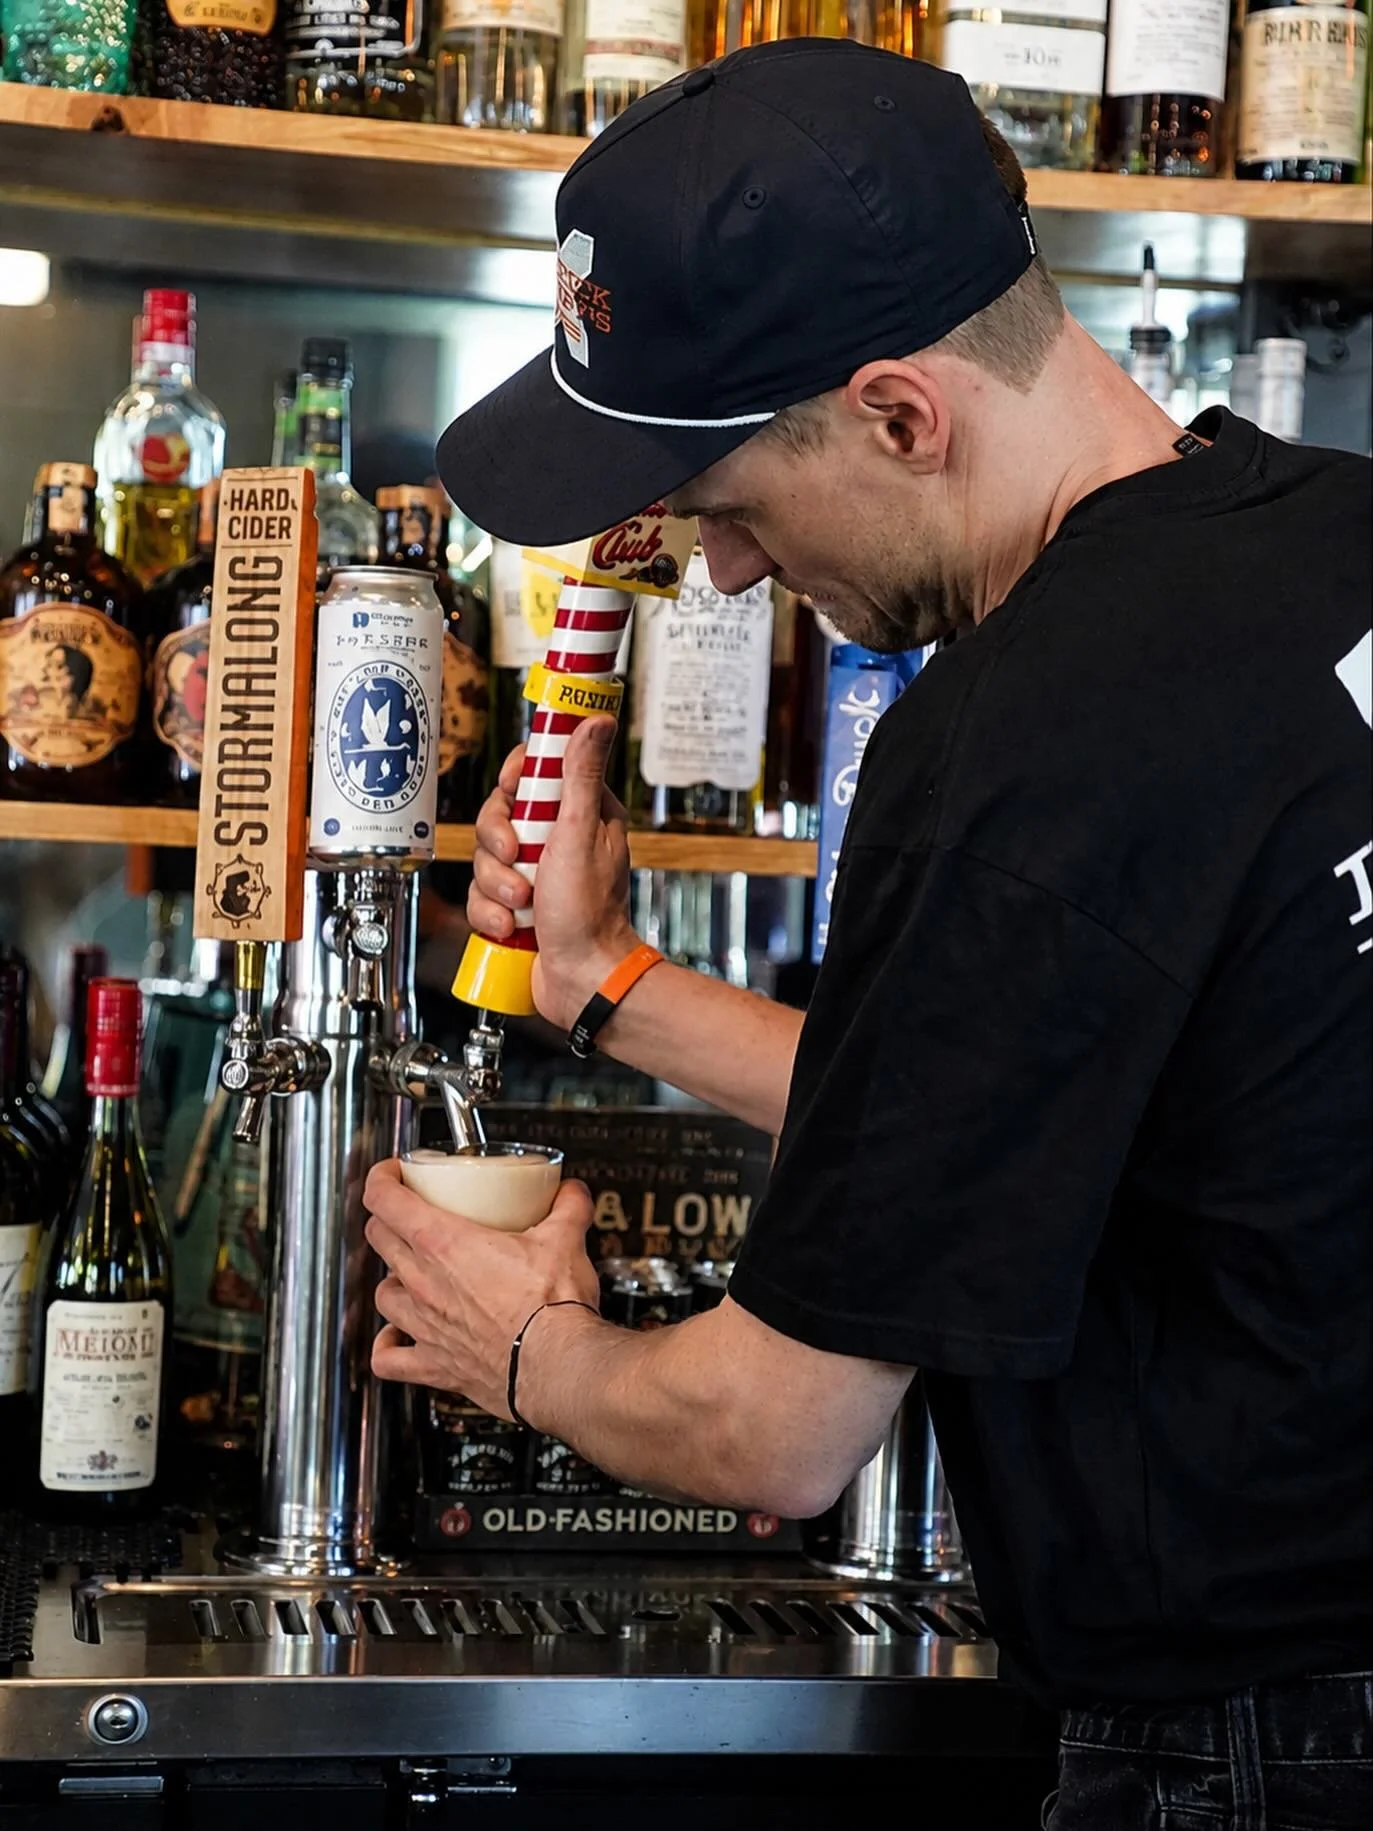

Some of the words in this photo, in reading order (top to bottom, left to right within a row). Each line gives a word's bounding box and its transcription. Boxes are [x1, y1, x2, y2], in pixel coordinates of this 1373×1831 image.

[230, 487, 290, 512] HARD
[228, 515, 292, 540] CIDER
[213, 555, 284, 846] STORMALONG
[642, 1191, 752, 1237] LOW
